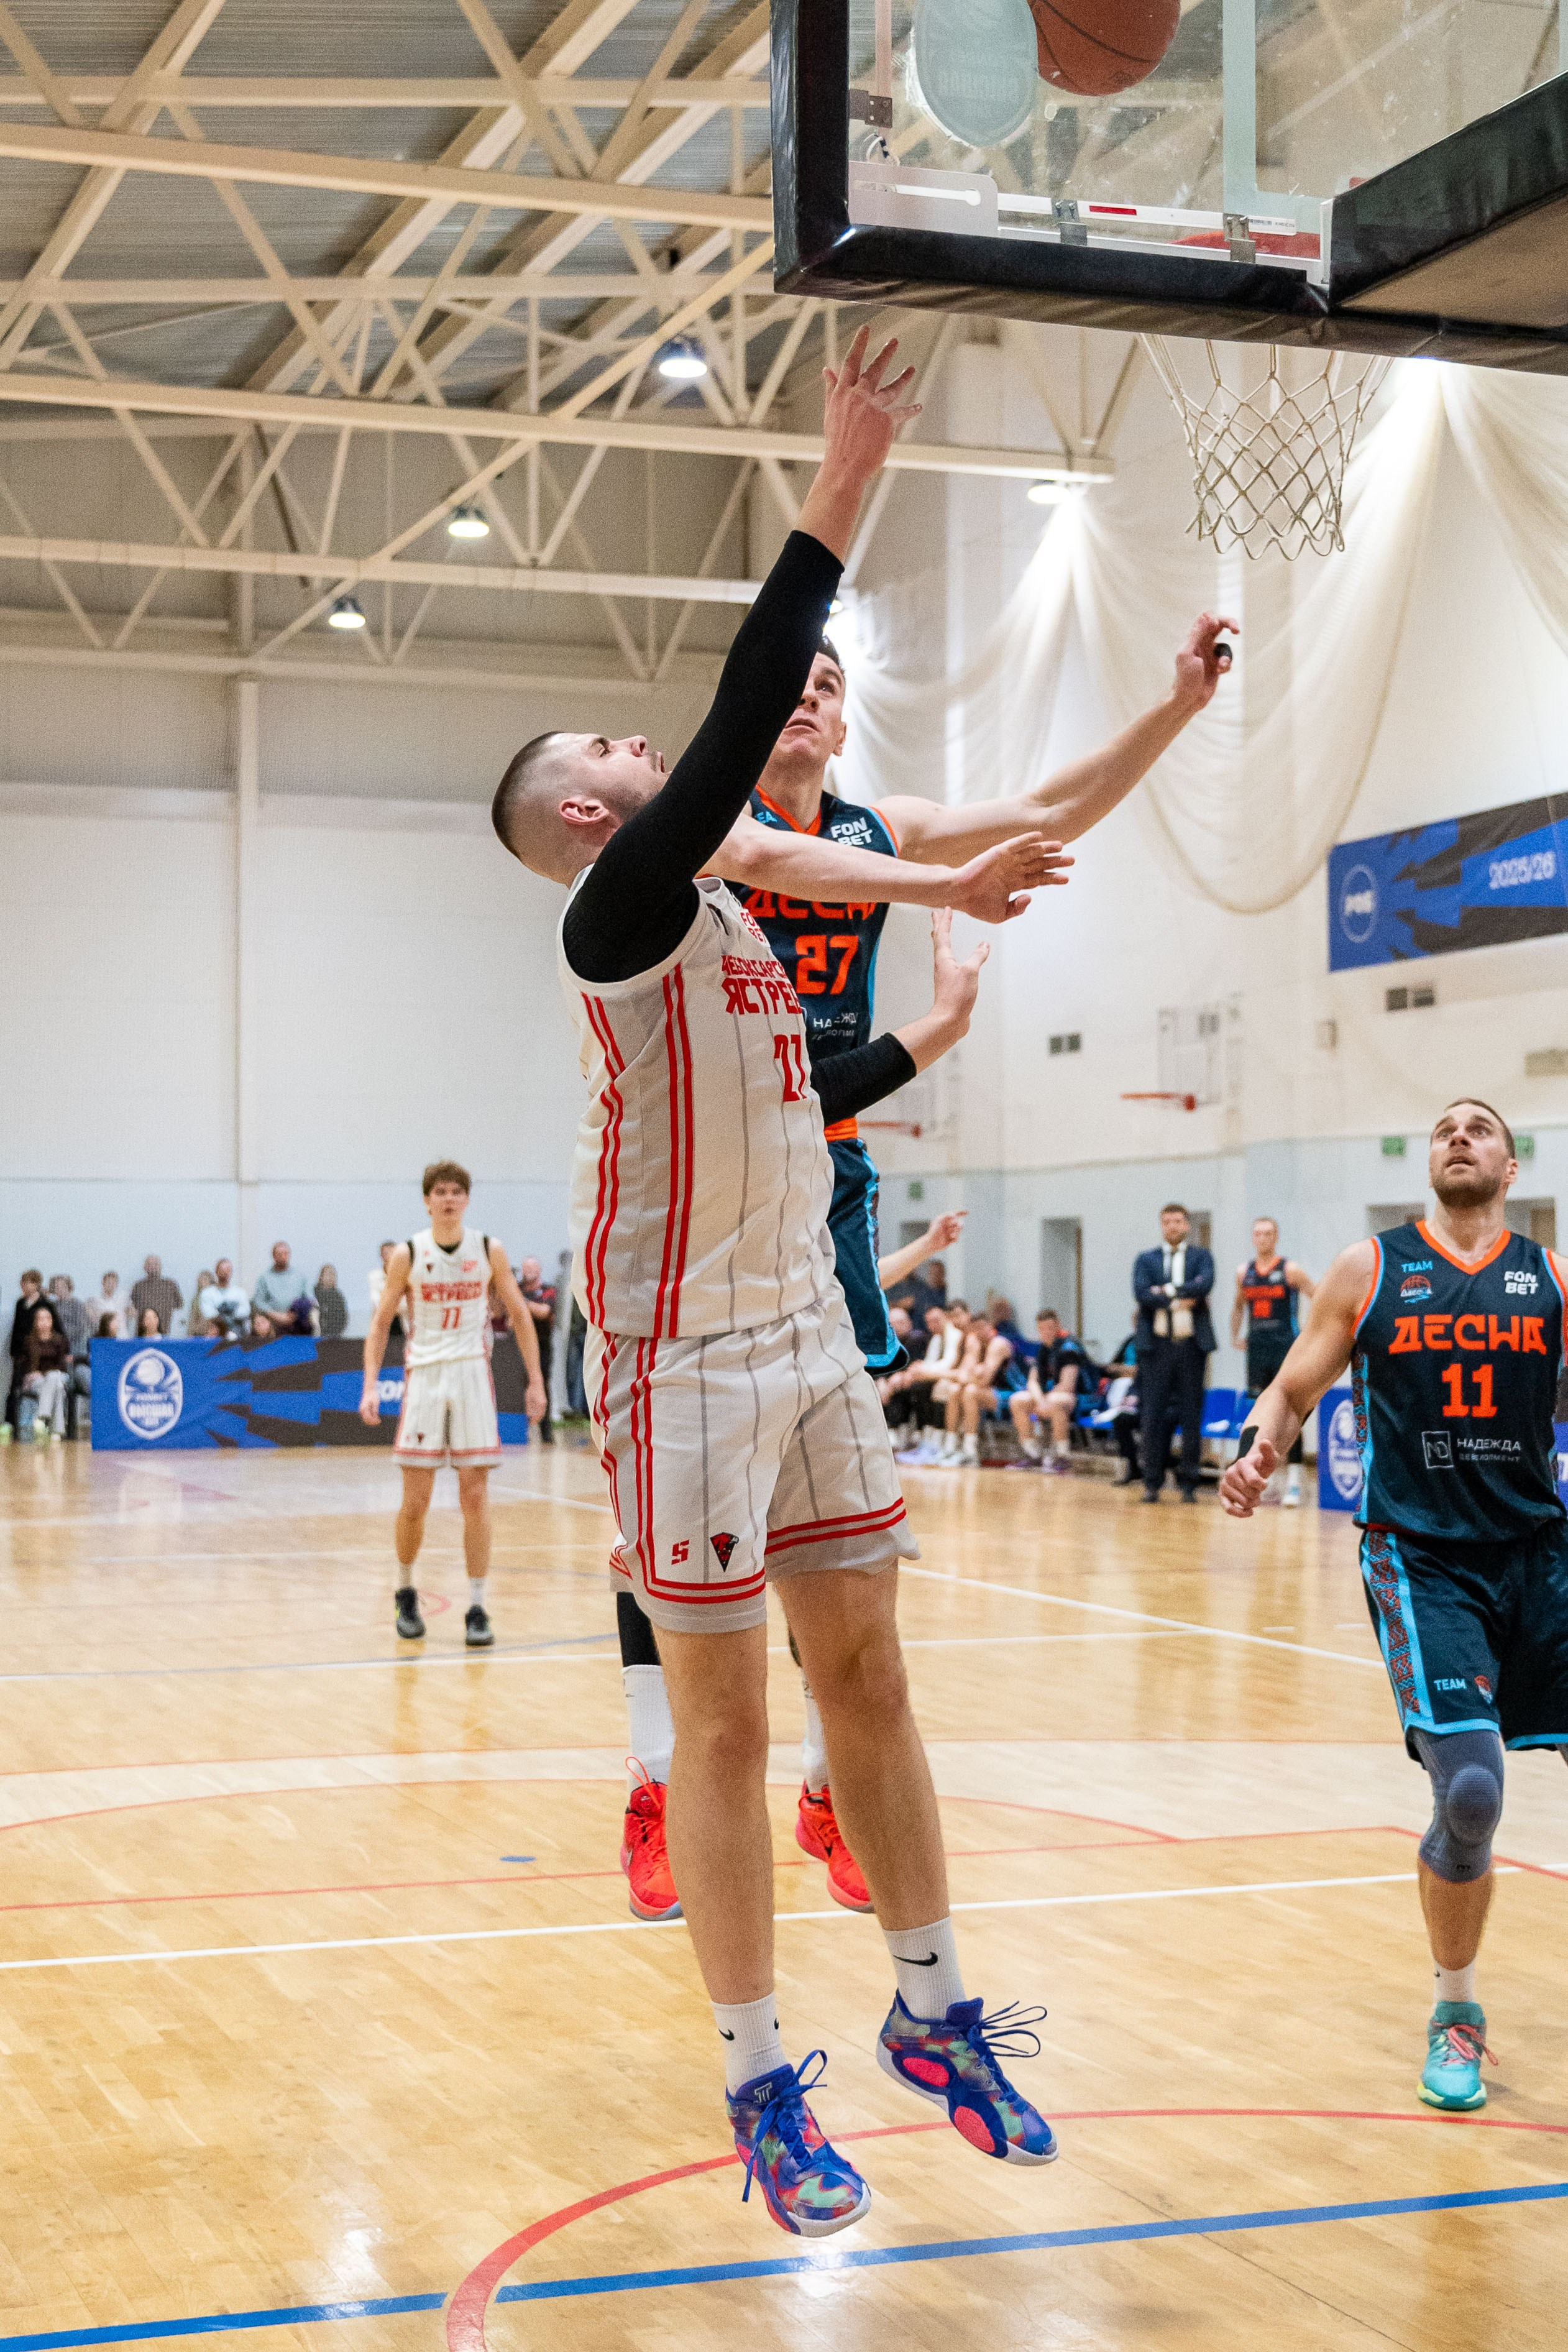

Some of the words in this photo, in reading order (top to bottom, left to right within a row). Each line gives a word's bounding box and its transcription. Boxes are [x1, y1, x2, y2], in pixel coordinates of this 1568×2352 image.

[754, 811, 777, 824] EA
[831, 817, 868, 838] FON
[838, 830, 873, 846] BET
[740, 912, 756, 927] FO
[795, 935, 859, 995] 27
[1401, 1261, 1433, 1273] TEAM
[1504, 1270, 1537, 1283] FON
[1505, 1282, 1538, 1295] BET
[1388, 1313, 1547, 1355] ДЕСНА
[1441, 1363, 1498, 1418] 11
[1457, 1438, 1522, 1452] НАДЕЖДА
[1434, 1678, 1467, 1691] TEAM
